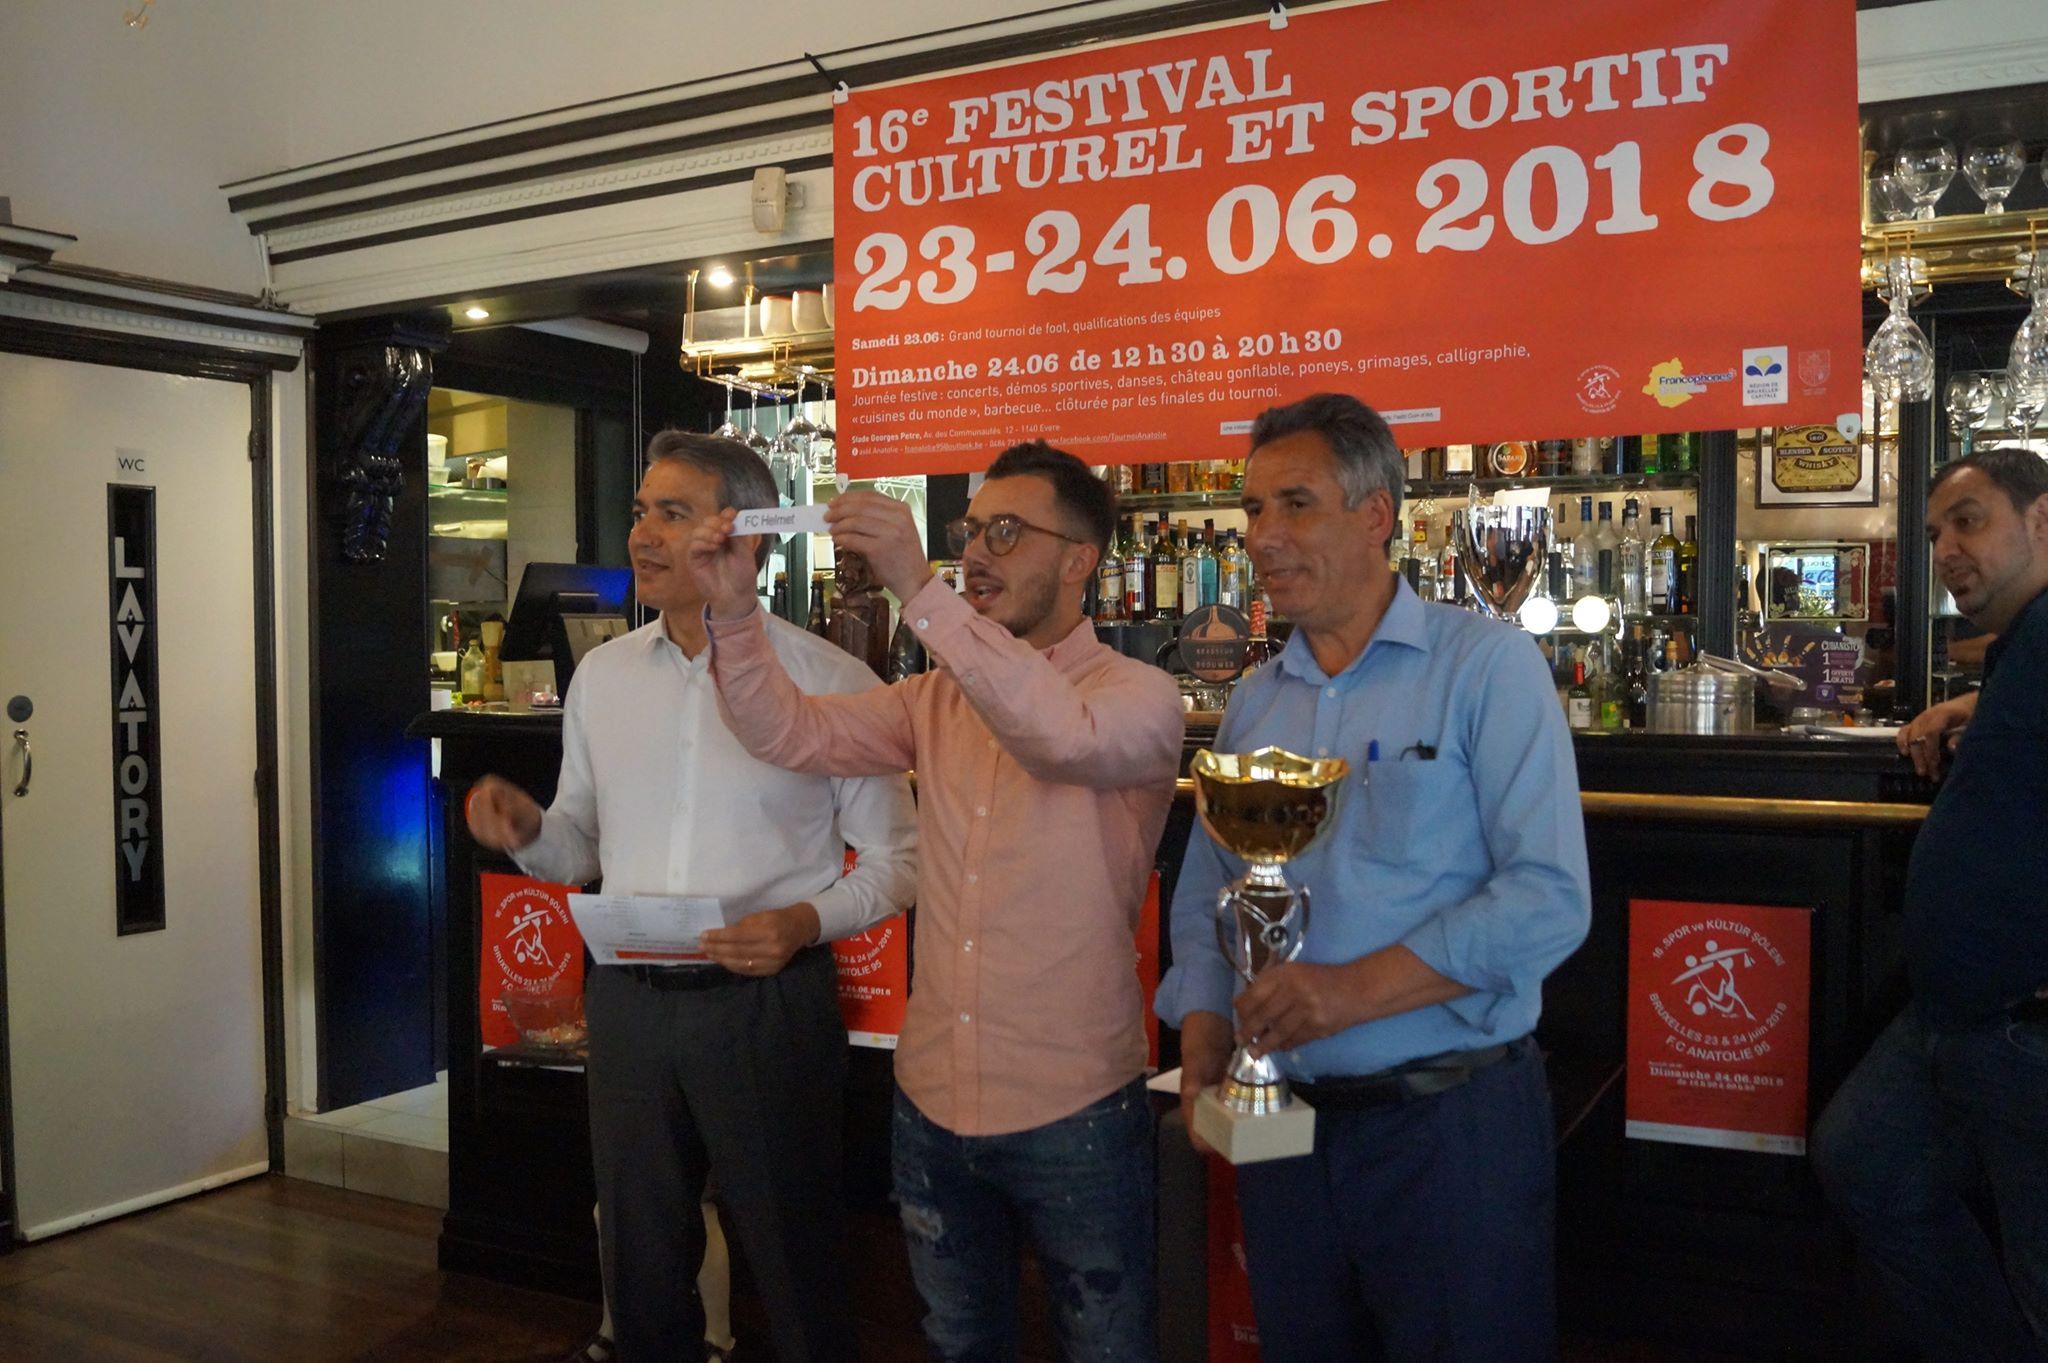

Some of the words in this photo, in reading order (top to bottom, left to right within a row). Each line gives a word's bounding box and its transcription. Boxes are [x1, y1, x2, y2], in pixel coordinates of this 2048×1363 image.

[945, 48, 1292, 145] FESTIVAL
[852, 123, 1202, 212] CULTUREL
[1225, 102, 1325, 164] ET
[1350, 43, 1729, 146] SPORTIF
[851, 334, 900, 351] Samedi
[949, 328, 983, 342] Grand
[985, 326, 1026, 340] tournoi
[1029, 324, 1043, 336] de
[1046, 320, 1071, 336] foot,
[1073, 313, 1147, 334] qualifications
[1150, 310, 1171, 325] des
[1174, 306, 1222, 325] équipes
[851, 358, 978, 389] Dimanche
[986, 354, 1060, 378] 24.06
[1070, 349, 1101, 373] de
[1212, 334, 1230, 361] à
[852, 390, 897, 407] Journée
[947, 386, 1002, 402] concerts,
[1006, 380, 1047, 396] démos
[1051, 377, 1113, 396] sportives,
[1117, 373, 1167, 390] danses,
[1170, 367, 1222, 385] château
[1226, 361, 1295, 383] gonflable,
[1299, 357, 1353, 378] poneys,
[1357, 352, 1432, 372] grimages,
[908, 408, 924, 422] du
[1055, 393, 1109, 412] clôturée
[1111, 394, 1135, 411] par
[1137, 392, 1158, 407] les
[1160, 388, 1205, 405] finales
[1208, 387, 1225, 402] du
[1228, 383, 1283, 400] tournoi.
[870, 433, 899, 445] Georges
[1780, 447, 1812, 456] BLENDED
[1822, 446, 1853, 454] SCOTCH
[118, 457, 145, 472] WC
[1799, 459, 1834, 469] WHISKY
[744, 514, 759, 527] FC
[761, 514, 796, 526] Helmet
[1822, 651, 1831, 665] 1
[1822, 668, 1831, 684] 1
[114, 537, 150, 882] LAVATORY
[1706, 918, 1751, 938] KÜLTÜR
[878, 928, 893, 949] 2018
[1650, 992, 1702, 1042] BRUXELLES
[1704, 1034, 1718, 1045] 23
[1733, 1033, 1747, 1044] 24
[1766, 1001, 1788, 1030] 2018
[1686, 1046, 1753, 1062] ANATOLIE
[1649, 1066, 1711, 1080] Dimanche
